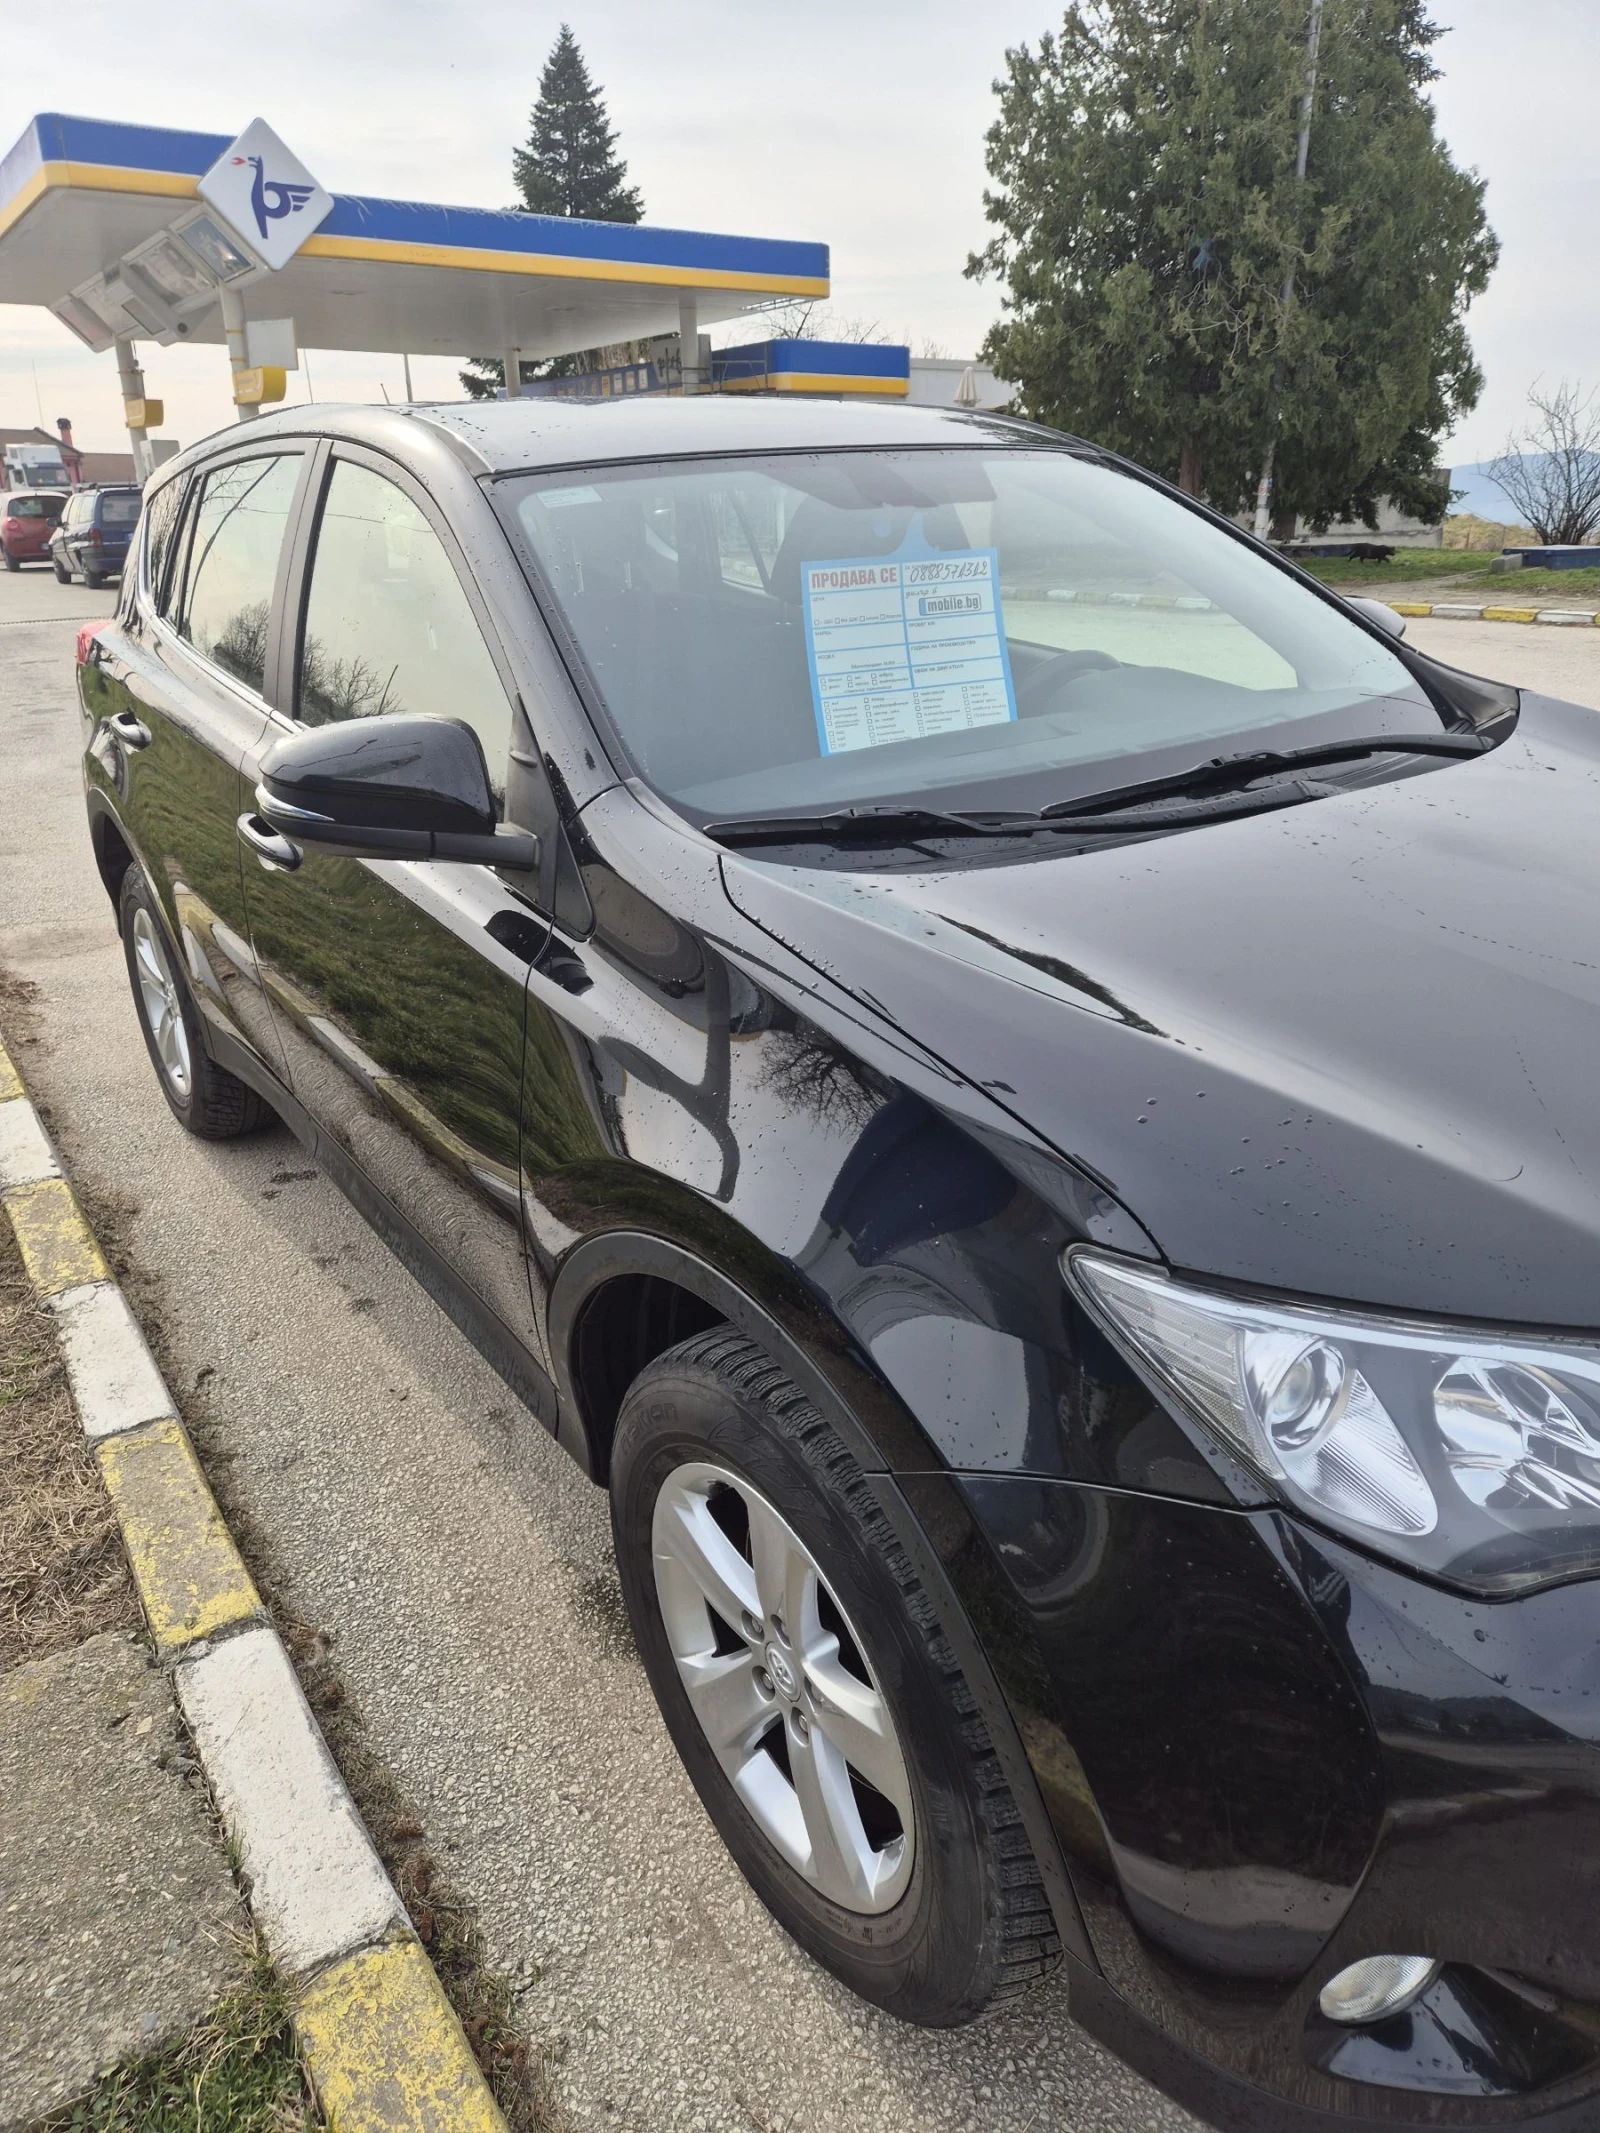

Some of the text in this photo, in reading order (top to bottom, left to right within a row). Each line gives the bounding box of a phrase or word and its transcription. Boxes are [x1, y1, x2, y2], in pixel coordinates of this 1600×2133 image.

[811, 567, 897, 588] ПРОДАВА СЕ
[910, 561, 988, 583] 0888571312
[927, 596, 979, 612] mobile.bg
